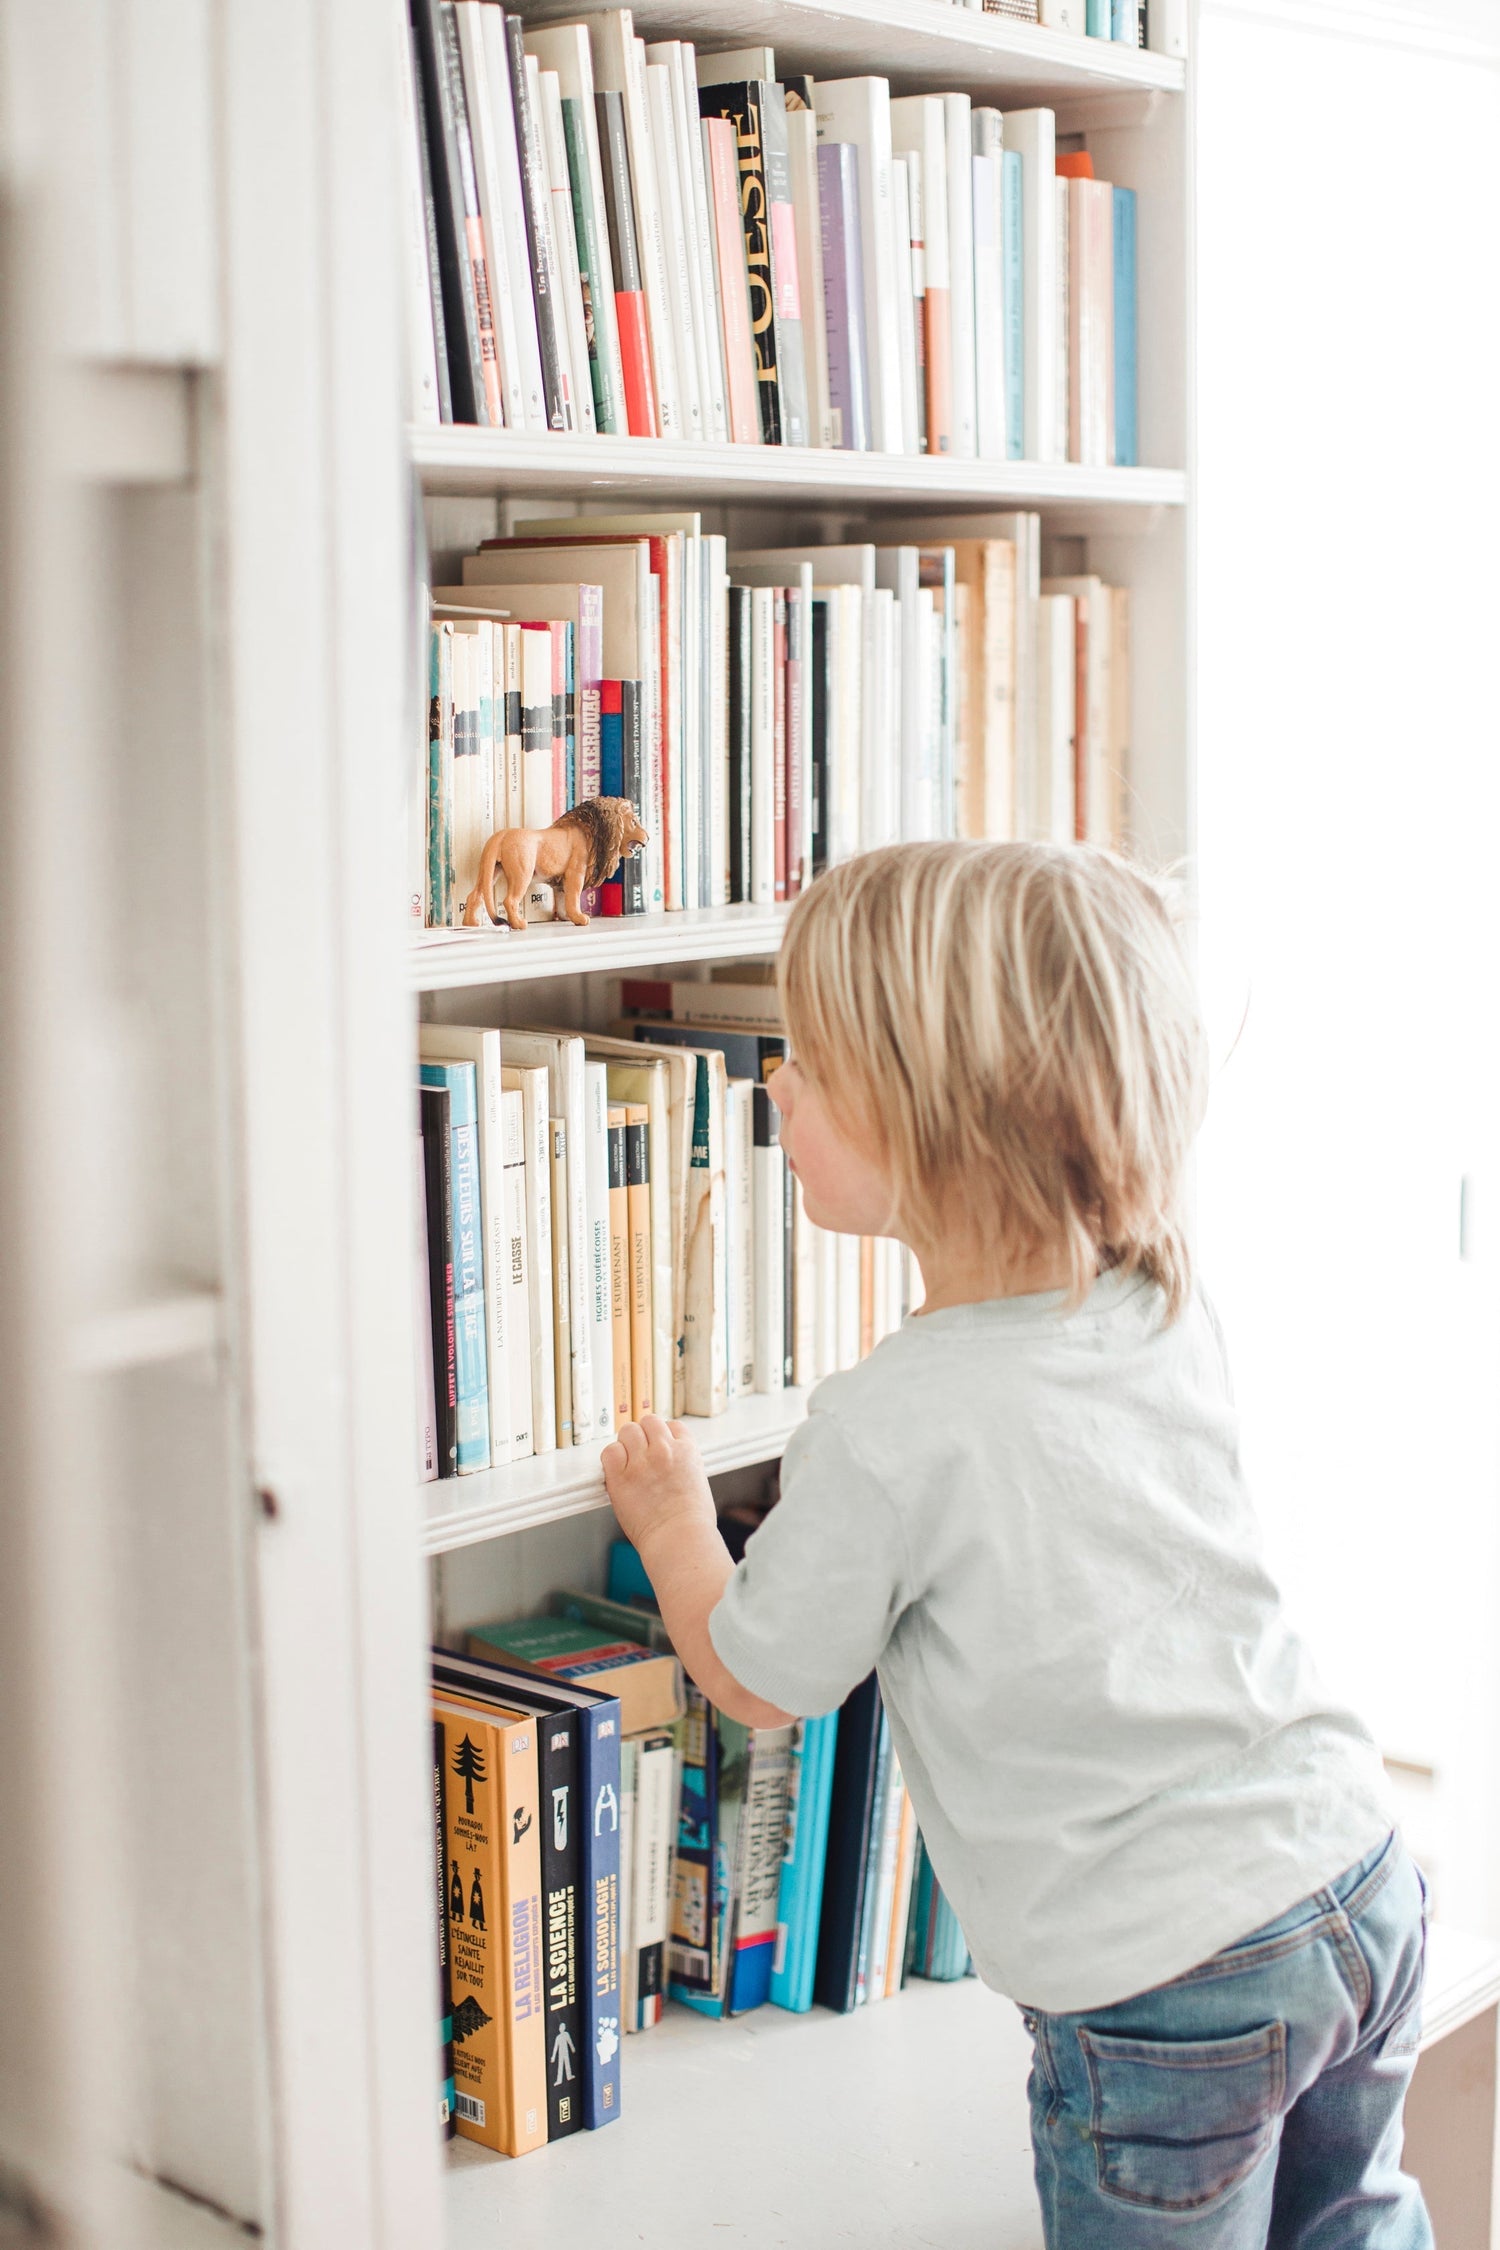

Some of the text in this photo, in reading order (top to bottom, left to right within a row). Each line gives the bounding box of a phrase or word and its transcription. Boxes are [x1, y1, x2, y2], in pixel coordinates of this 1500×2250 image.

[536, 275, 547, 294] Un
[661, 401, 670, 427] XYZ
[583, 690, 601, 800] CK KEROUAC
[633, 701, 641, 779] Jean-Paul DAOUST
[633, 885, 641, 908] XYZ
[457, 1126, 478, 1342] DES FLEURS SUR LA NEIGE
[493, 1215, 502, 1262] CINÉASTE
[445, 1263, 453, 1283] WEB
[512, 1274, 523, 1285] LE
[593, 1220, 603, 1323] FIGURES QUÉBÉCOISES
[612, 1234, 623, 1318] LE SURVENANT
[635, 1232, 645, 1314] LE SURVENANT
[446, 1285, 454, 1296] LE
[446, 1297, 454, 1316] SUR
[495, 1294, 503, 1334] NATURE
[447, 1319, 455, 1362] VOLONTÉ
[496, 1334, 504, 1348] LA
[448, 1374, 456, 1408] BUFFET
[454, 1826, 488, 1845] SOMMES-NOUS
[458, 1816, 483, 1831] POURQUOI
[746, 1780, 768, 1919] DICTIONARY
[434, 1764, 447, 1967] PROPRES GÉOGRAPHIQUES DU QUÉBEC
[451, 1927, 487, 1950] L'ÉTINCELLE
[548, 1888, 568, 2011] LA SCIENCE
[595, 1877, 610, 1998] LA SOCIOLOGIE
[457, 1944, 481, 1961] SAINTE
[512, 1898, 533, 2022] LA RELIGION
[454, 1958, 485, 1975] REJAILLIT
[456, 1970, 484, 1989] SUR TOUS
[471, 2065, 483, 2075] AVEC
[474, 2055, 486, 2067] NOUS
